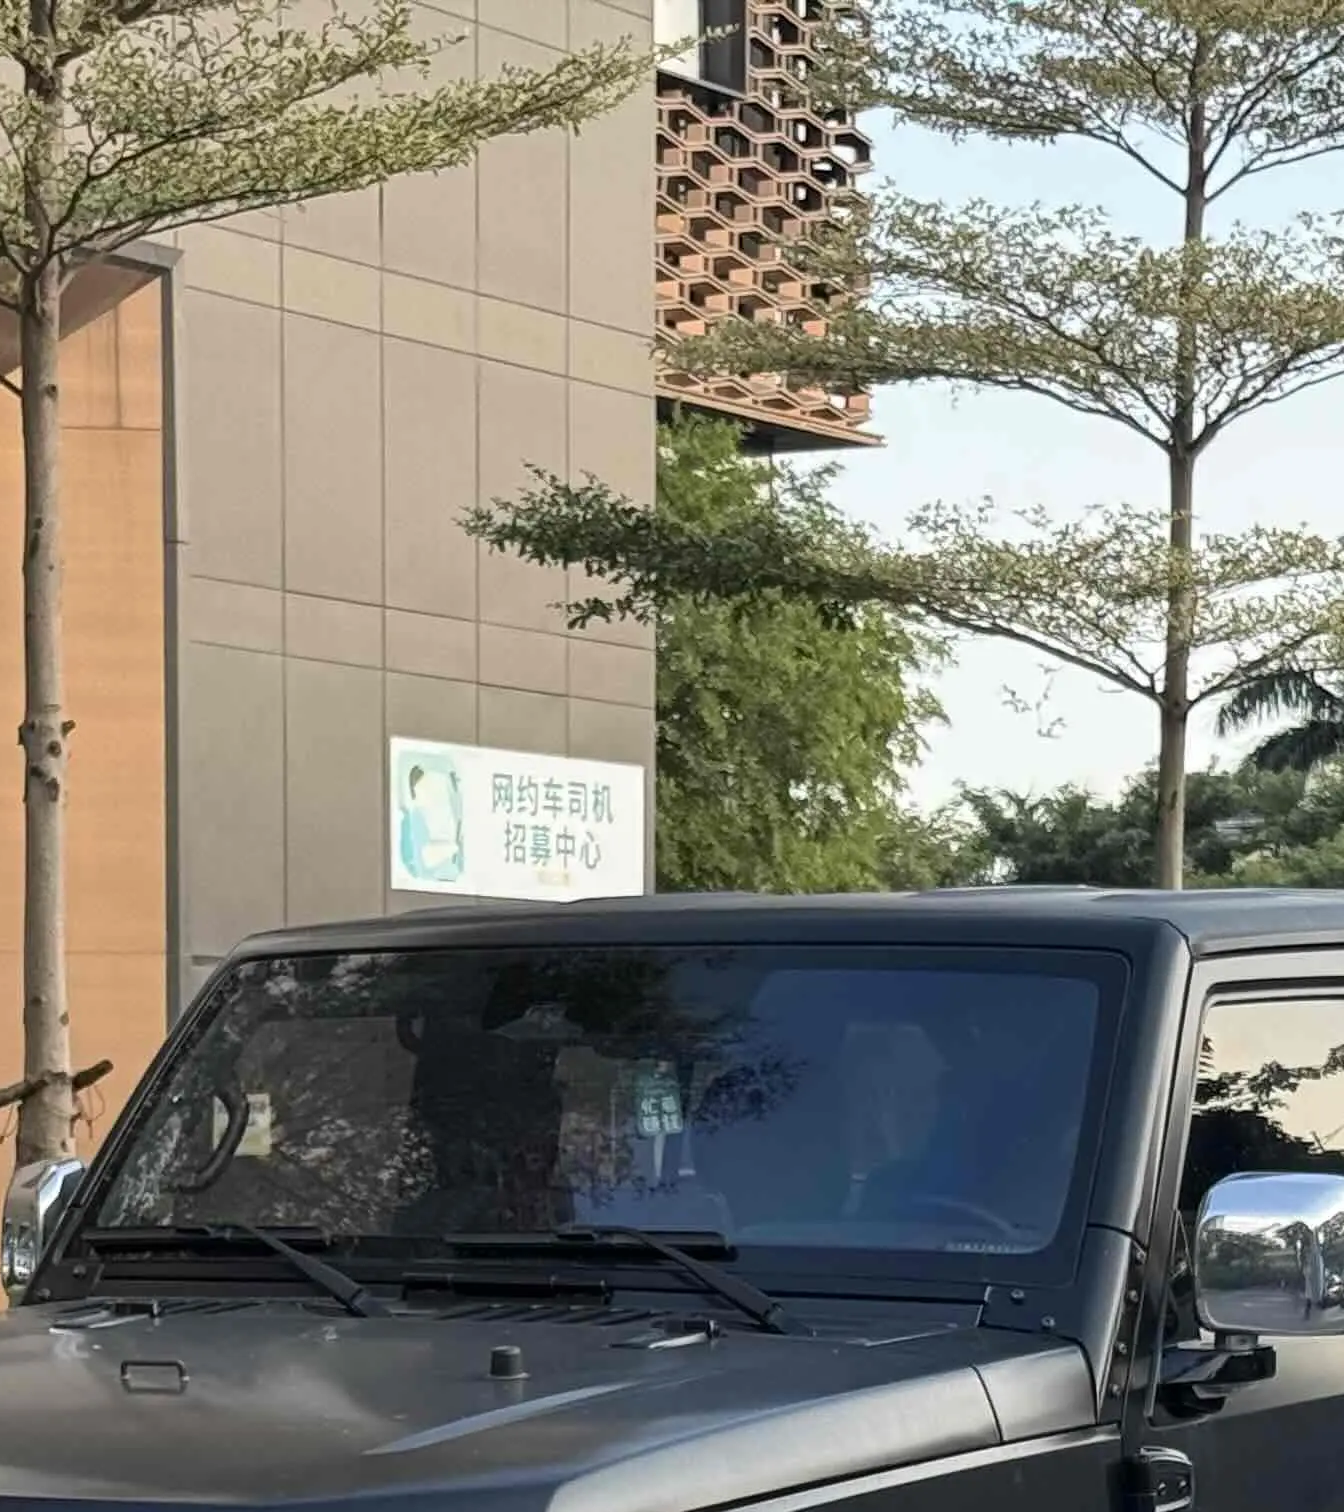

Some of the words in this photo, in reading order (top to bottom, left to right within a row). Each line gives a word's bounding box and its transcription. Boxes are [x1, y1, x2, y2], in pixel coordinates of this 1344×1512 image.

[491, 773, 614, 825] 网约车司机
[504, 823, 602, 870] 招募中心
